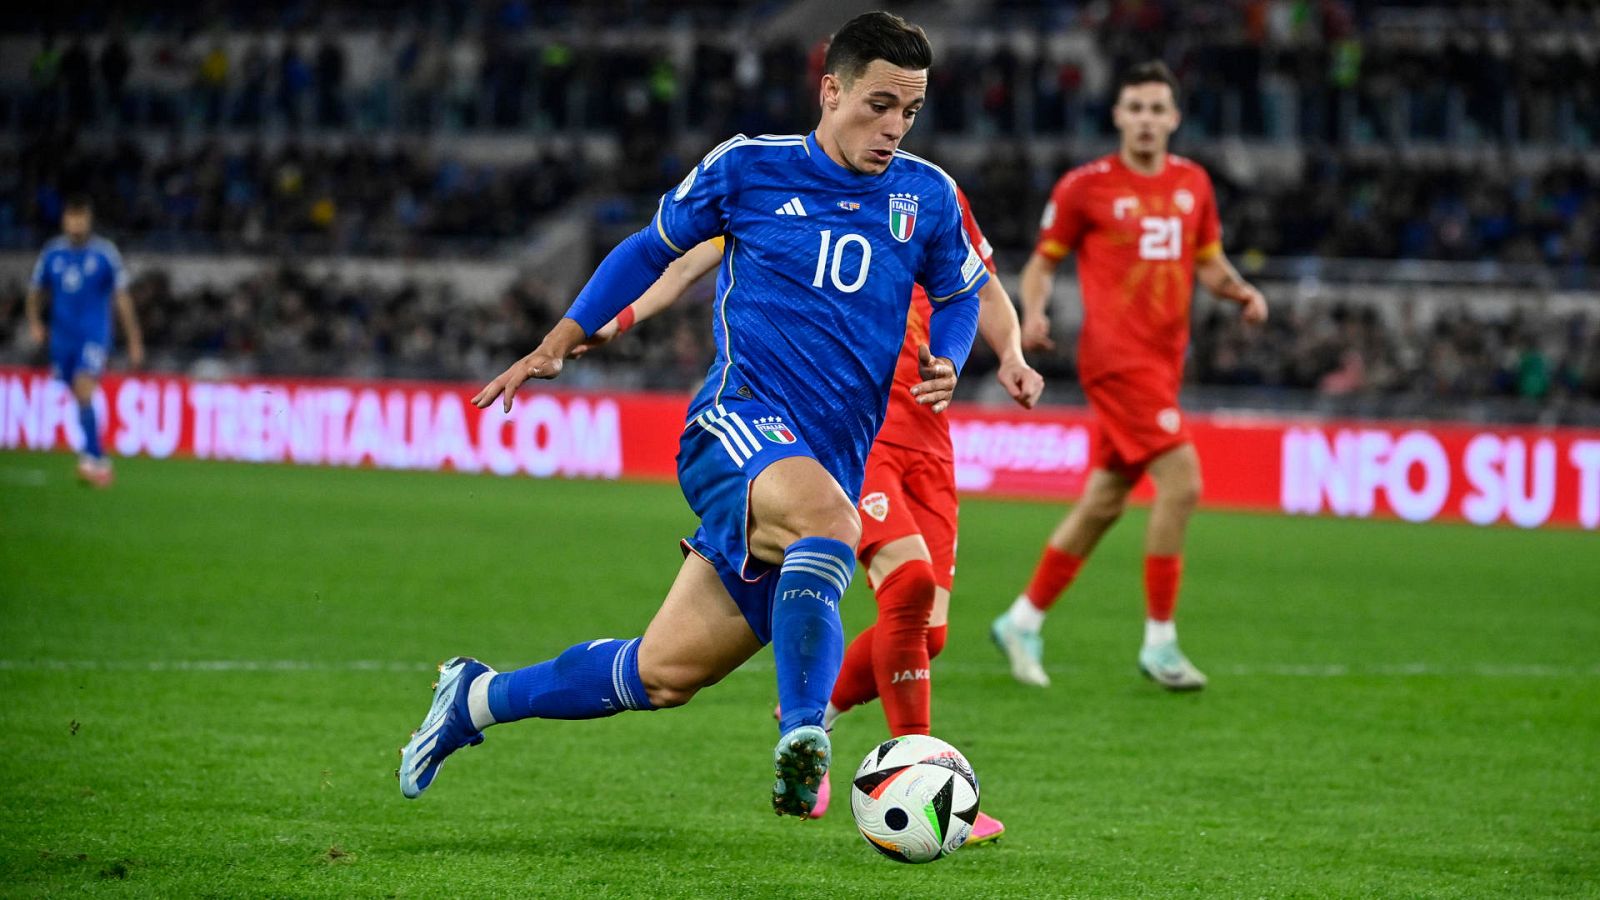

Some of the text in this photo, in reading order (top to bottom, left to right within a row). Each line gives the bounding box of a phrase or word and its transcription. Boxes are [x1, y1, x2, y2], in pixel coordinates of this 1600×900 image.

[892, 200, 916, 213] ITALIA
[812, 229, 871, 293] 10
[1139, 216, 1182, 260] 21
[115, 379, 182, 458] SU
[1281, 427, 1450, 522] INFO
[1461, 433, 1556, 528] SU
[782, 588, 835, 612] ITALIA
